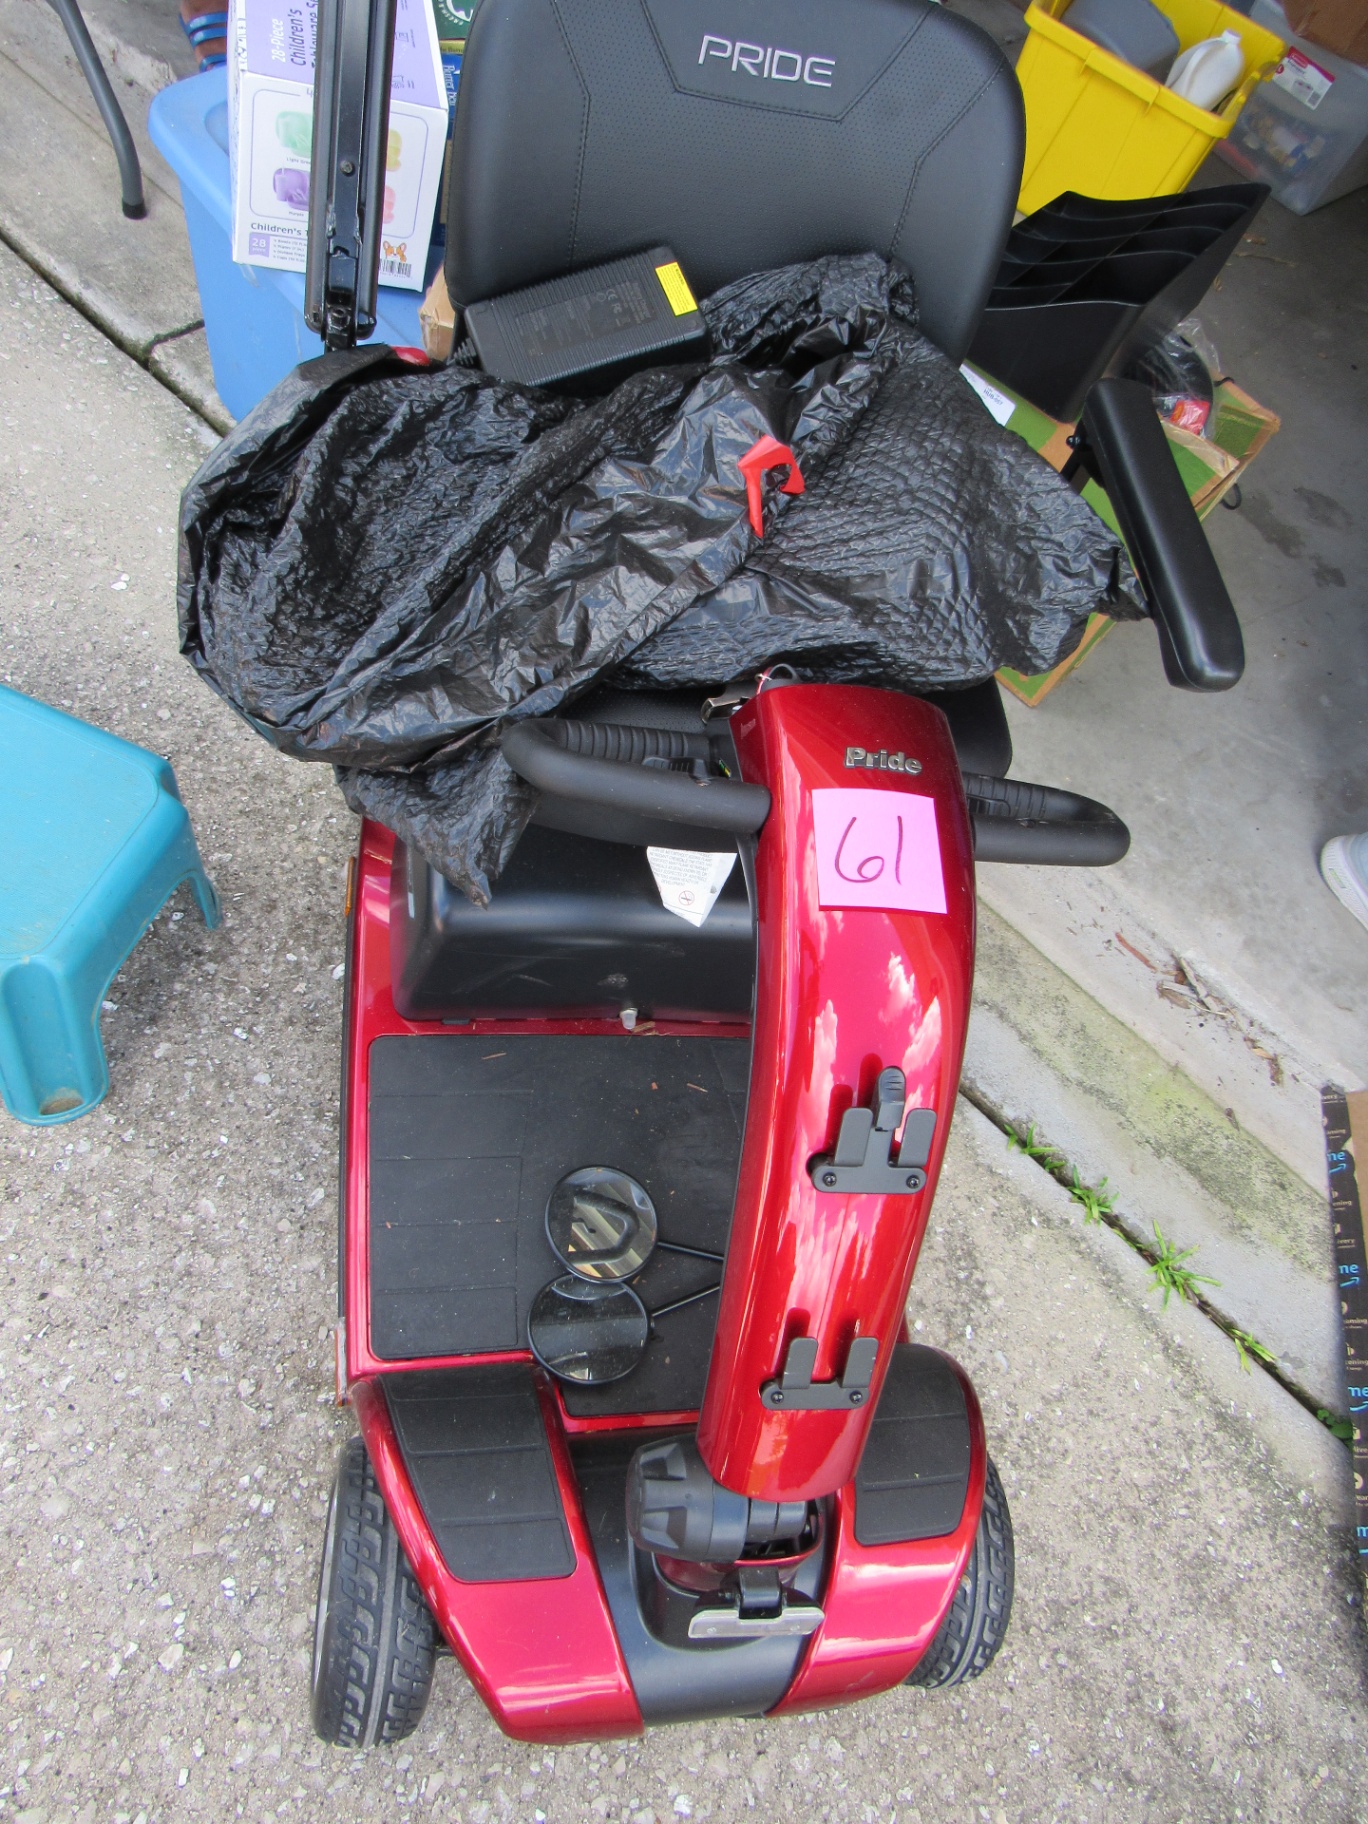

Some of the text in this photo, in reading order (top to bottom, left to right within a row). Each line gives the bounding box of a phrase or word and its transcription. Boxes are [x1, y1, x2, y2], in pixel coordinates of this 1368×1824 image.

[270, 18, 287, 63] 28-Piece
[287, 8, 307, 66] Children's
[698, 35, 836, 87] PRIDE
[250, 222, 302, 236] Children's
[252, 238, 266, 248] 28
[845, 746, 922, 774] Pride
[834, 815, 904, 886] 61
